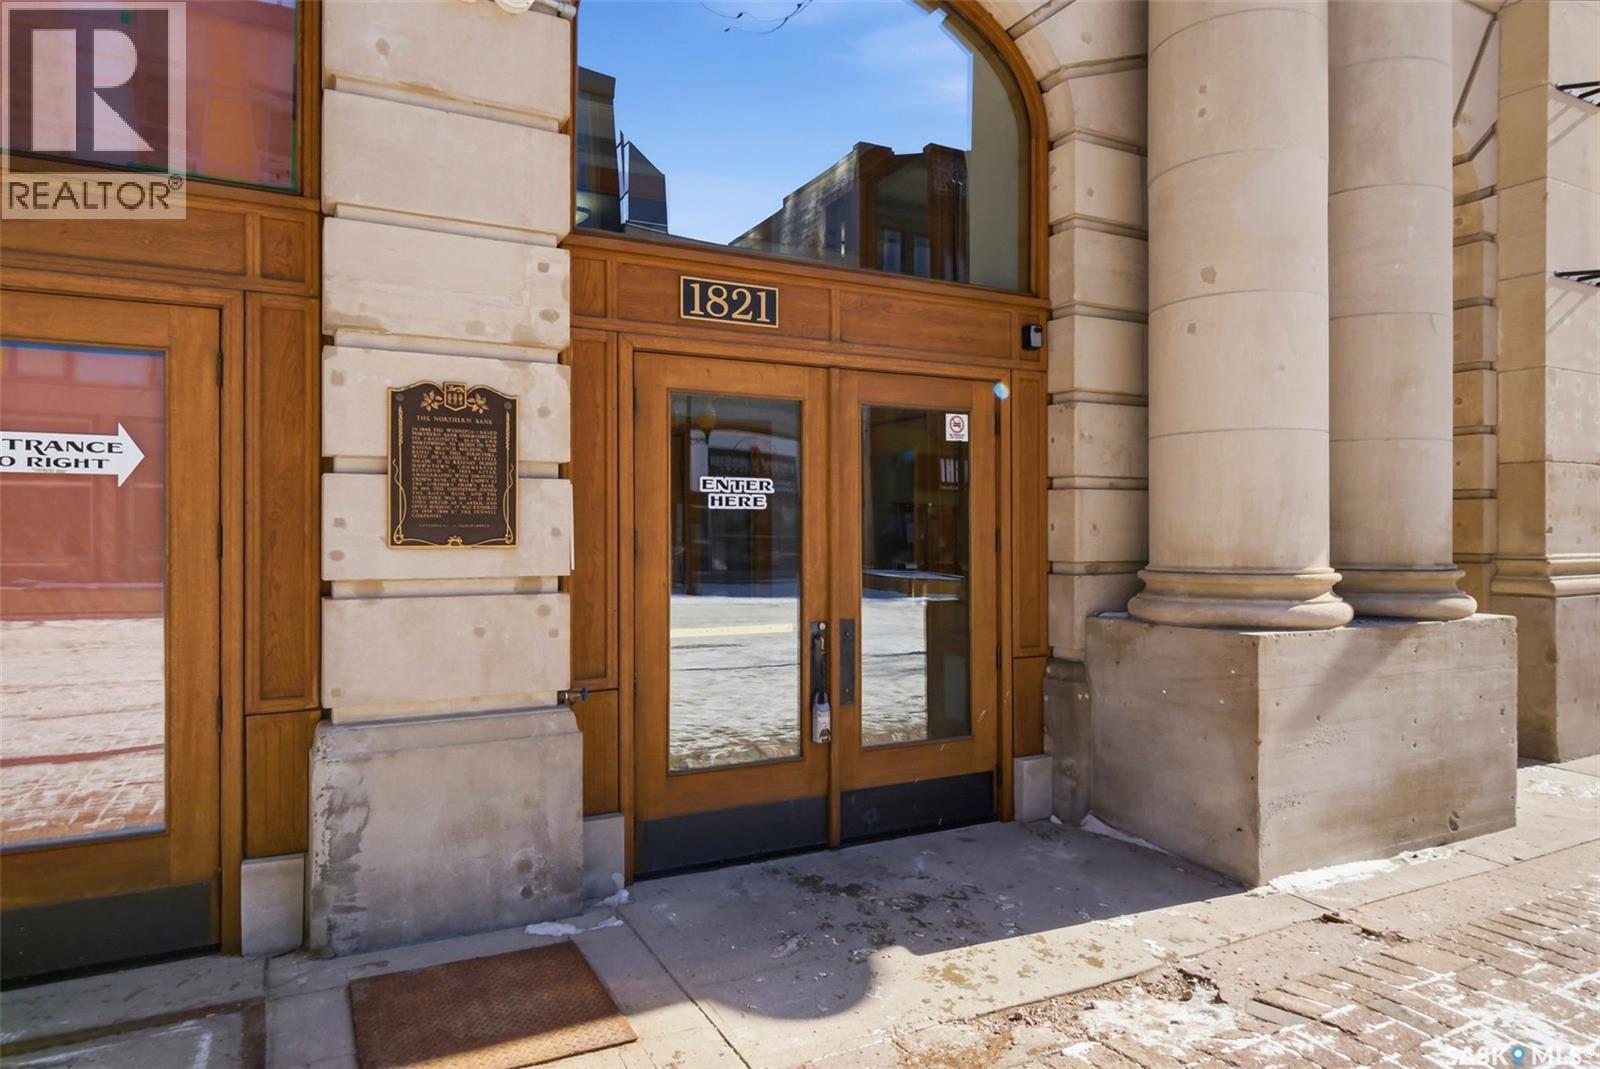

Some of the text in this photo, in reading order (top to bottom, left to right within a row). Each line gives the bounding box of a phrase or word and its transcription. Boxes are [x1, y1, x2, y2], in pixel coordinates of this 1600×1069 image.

[689, 283, 770, 323] 1821
[433, 416, 472, 424] NORTHERN
[27, 457, 110, 469] RIGHT
[701, 478, 773, 492] ENTER
[709, 495, 766, 507] HERE
